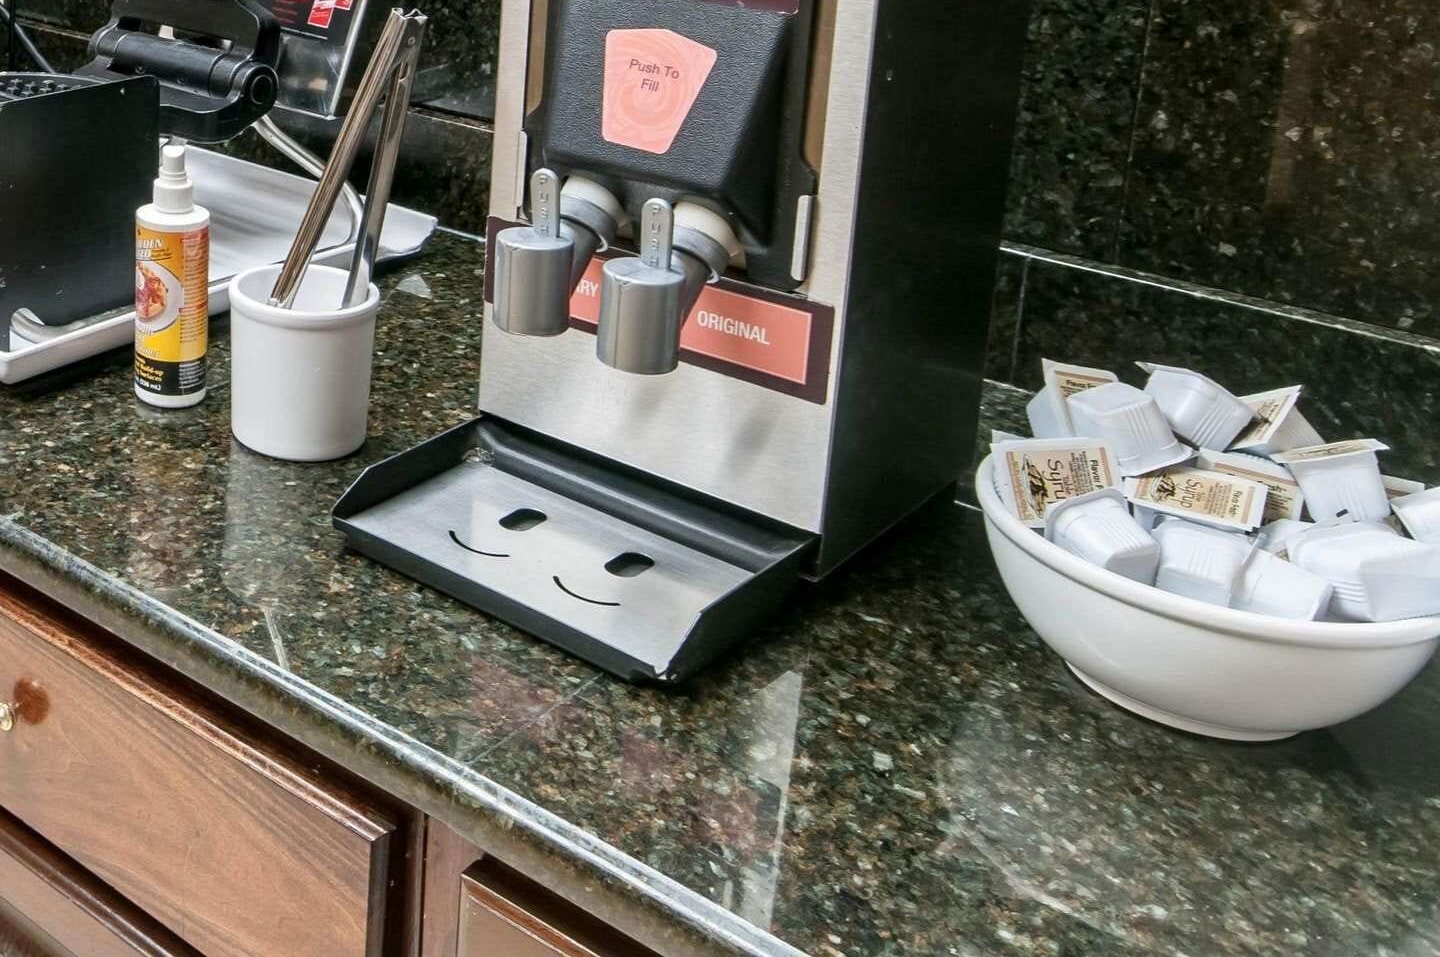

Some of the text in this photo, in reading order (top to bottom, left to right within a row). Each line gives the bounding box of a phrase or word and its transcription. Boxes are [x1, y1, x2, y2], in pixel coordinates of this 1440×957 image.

[629, 58, 680, 79] Push To
[641, 78, 660, 92] Fill
[697, 310, 770, 345] ORIGINAL
[1089, 459, 1102, 487] Flavor
[1171, 478, 1204, 509] Syrup
